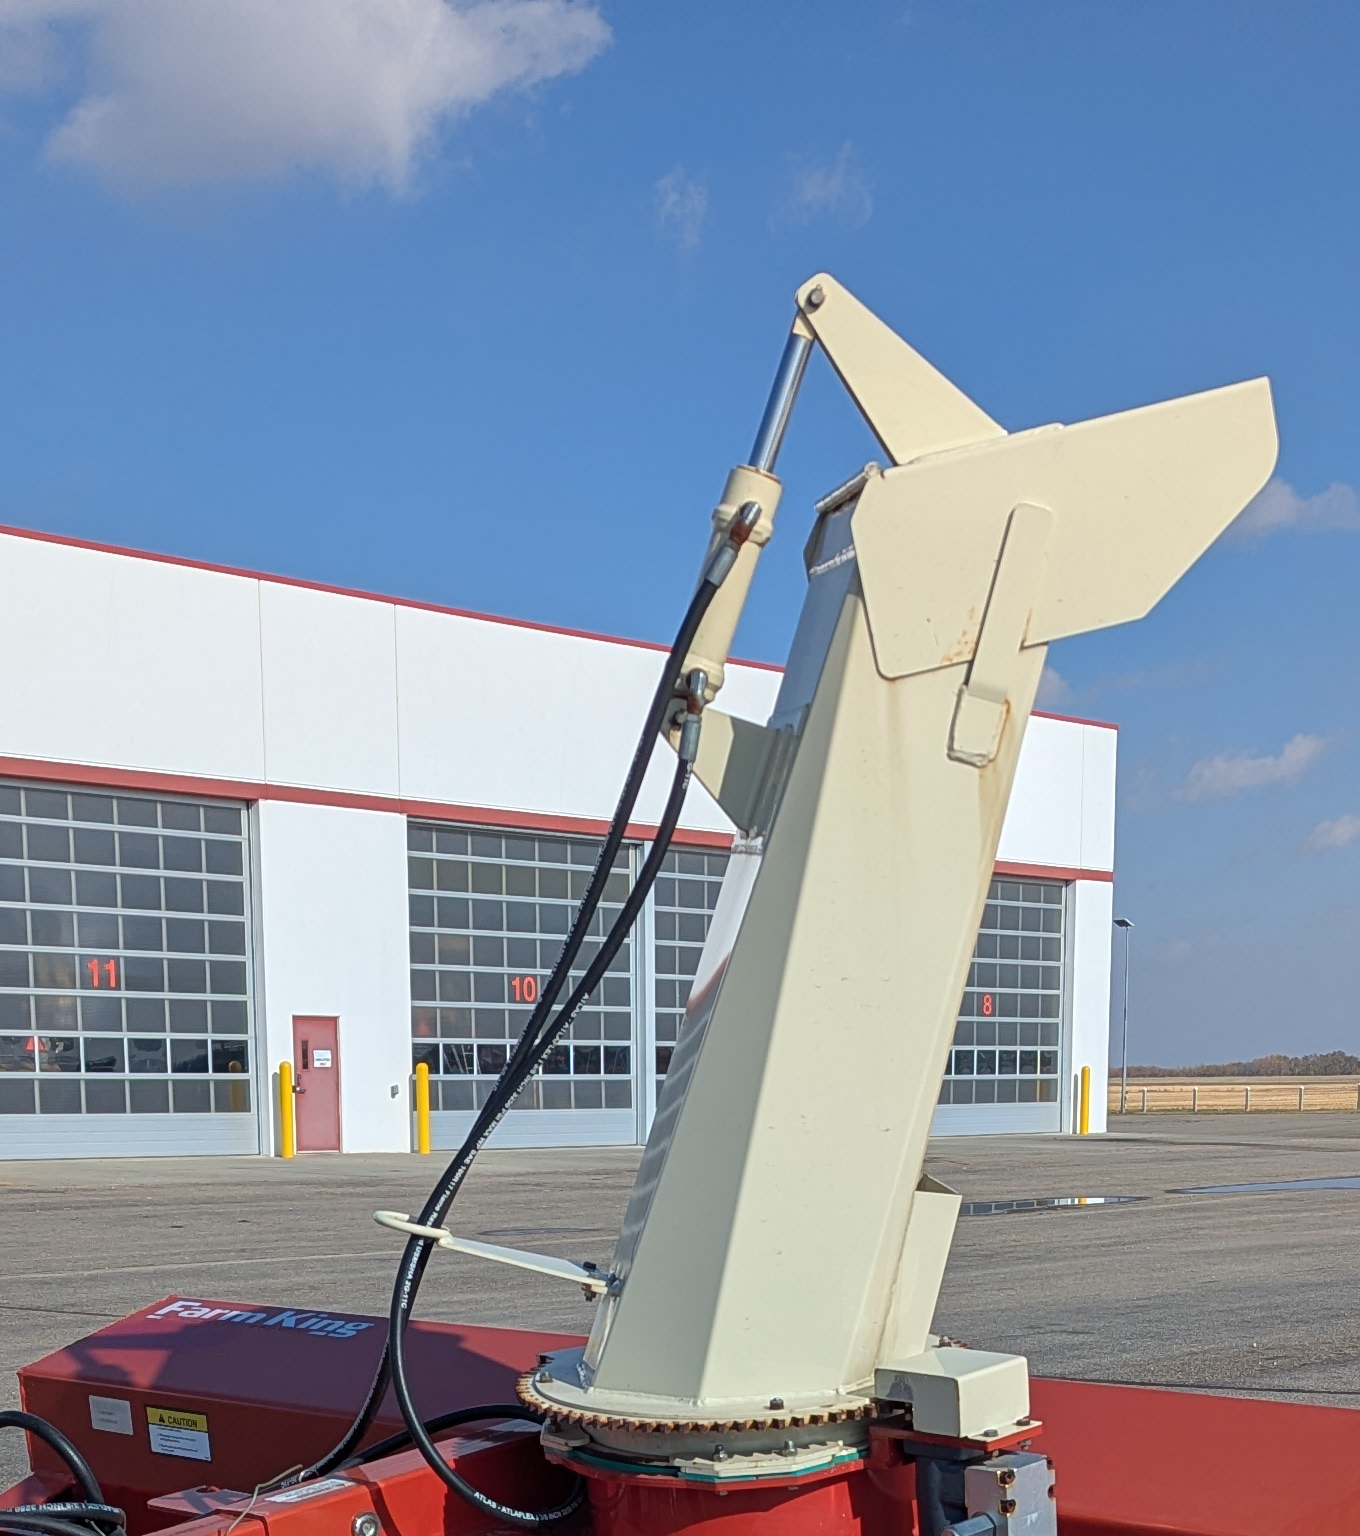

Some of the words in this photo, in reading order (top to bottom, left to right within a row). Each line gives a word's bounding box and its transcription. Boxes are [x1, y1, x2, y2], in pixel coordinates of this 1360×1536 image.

[87, 959, 116, 988] 11
[511, 976, 537, 1002] 10
[982, 994, 993, 1015] 8
[483, 1119, 498, 1137] MAX
[146, 1300, 267, 1324] Farm
[263, 1310, 375, 1338] King
[167, 1415, 198, 1429] CAUTION
[473, 1491, 497, 1509] ATLAS
